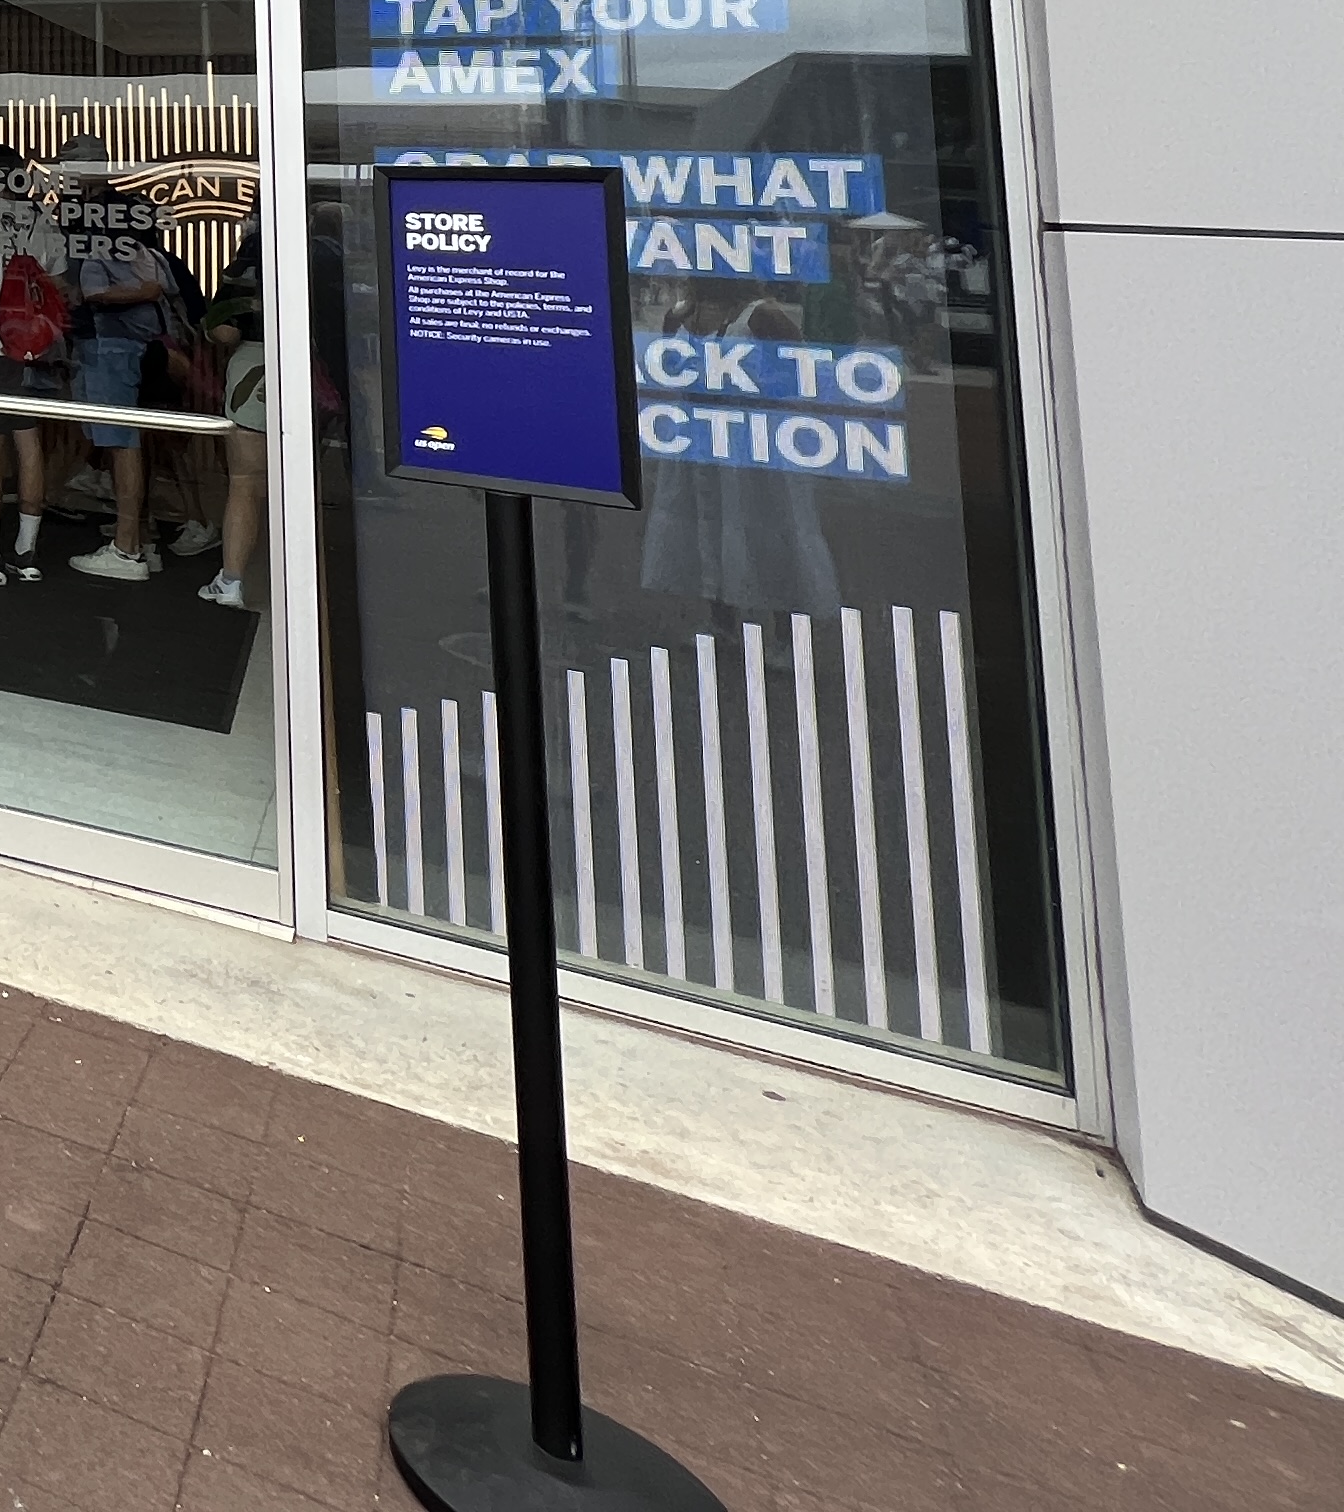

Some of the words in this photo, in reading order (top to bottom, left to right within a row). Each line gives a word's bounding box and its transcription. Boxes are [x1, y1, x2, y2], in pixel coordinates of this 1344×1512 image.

[388, 48, 598, 96] AMEX
[620, 155, 863, 210] WHAT
[14, 199, 179, 231] EXPRESS
[405, 213, 484, 232] STORE
[406, 233, 492, 252] POLICY
[628, 219, 807, 276] ANT
[407, 264, 426, 274] Levy
[452, 267, 493, 276] merchant
[505, 270, 534, 278] record
[408, 274, 447, 283] American
[449, 275, 482, 285] Express
[484, 277, 509, 286] Shop.
[408, 295, 431, 304] Shop
[447, 298, 478, 307] subject
[420, 288, 463, 297] purchases
[491, 290, 533, 300] American
[534, 292, 571, 302] Express
[408, 306, 452, 314] conditions
[463, 308, 483, 318] Levy
[503, 310, 530, 319] USTA.
[422, 318, 443, 326] sales
[495, 323, 528, 332] refunds
[446, 332, 482, 343] Security
[483, 336, 521, 345] cameras
[636, 337, 760, 394] CK
[779, 346, 902, 404] TO
[639, 404, 909, 477] CTION
